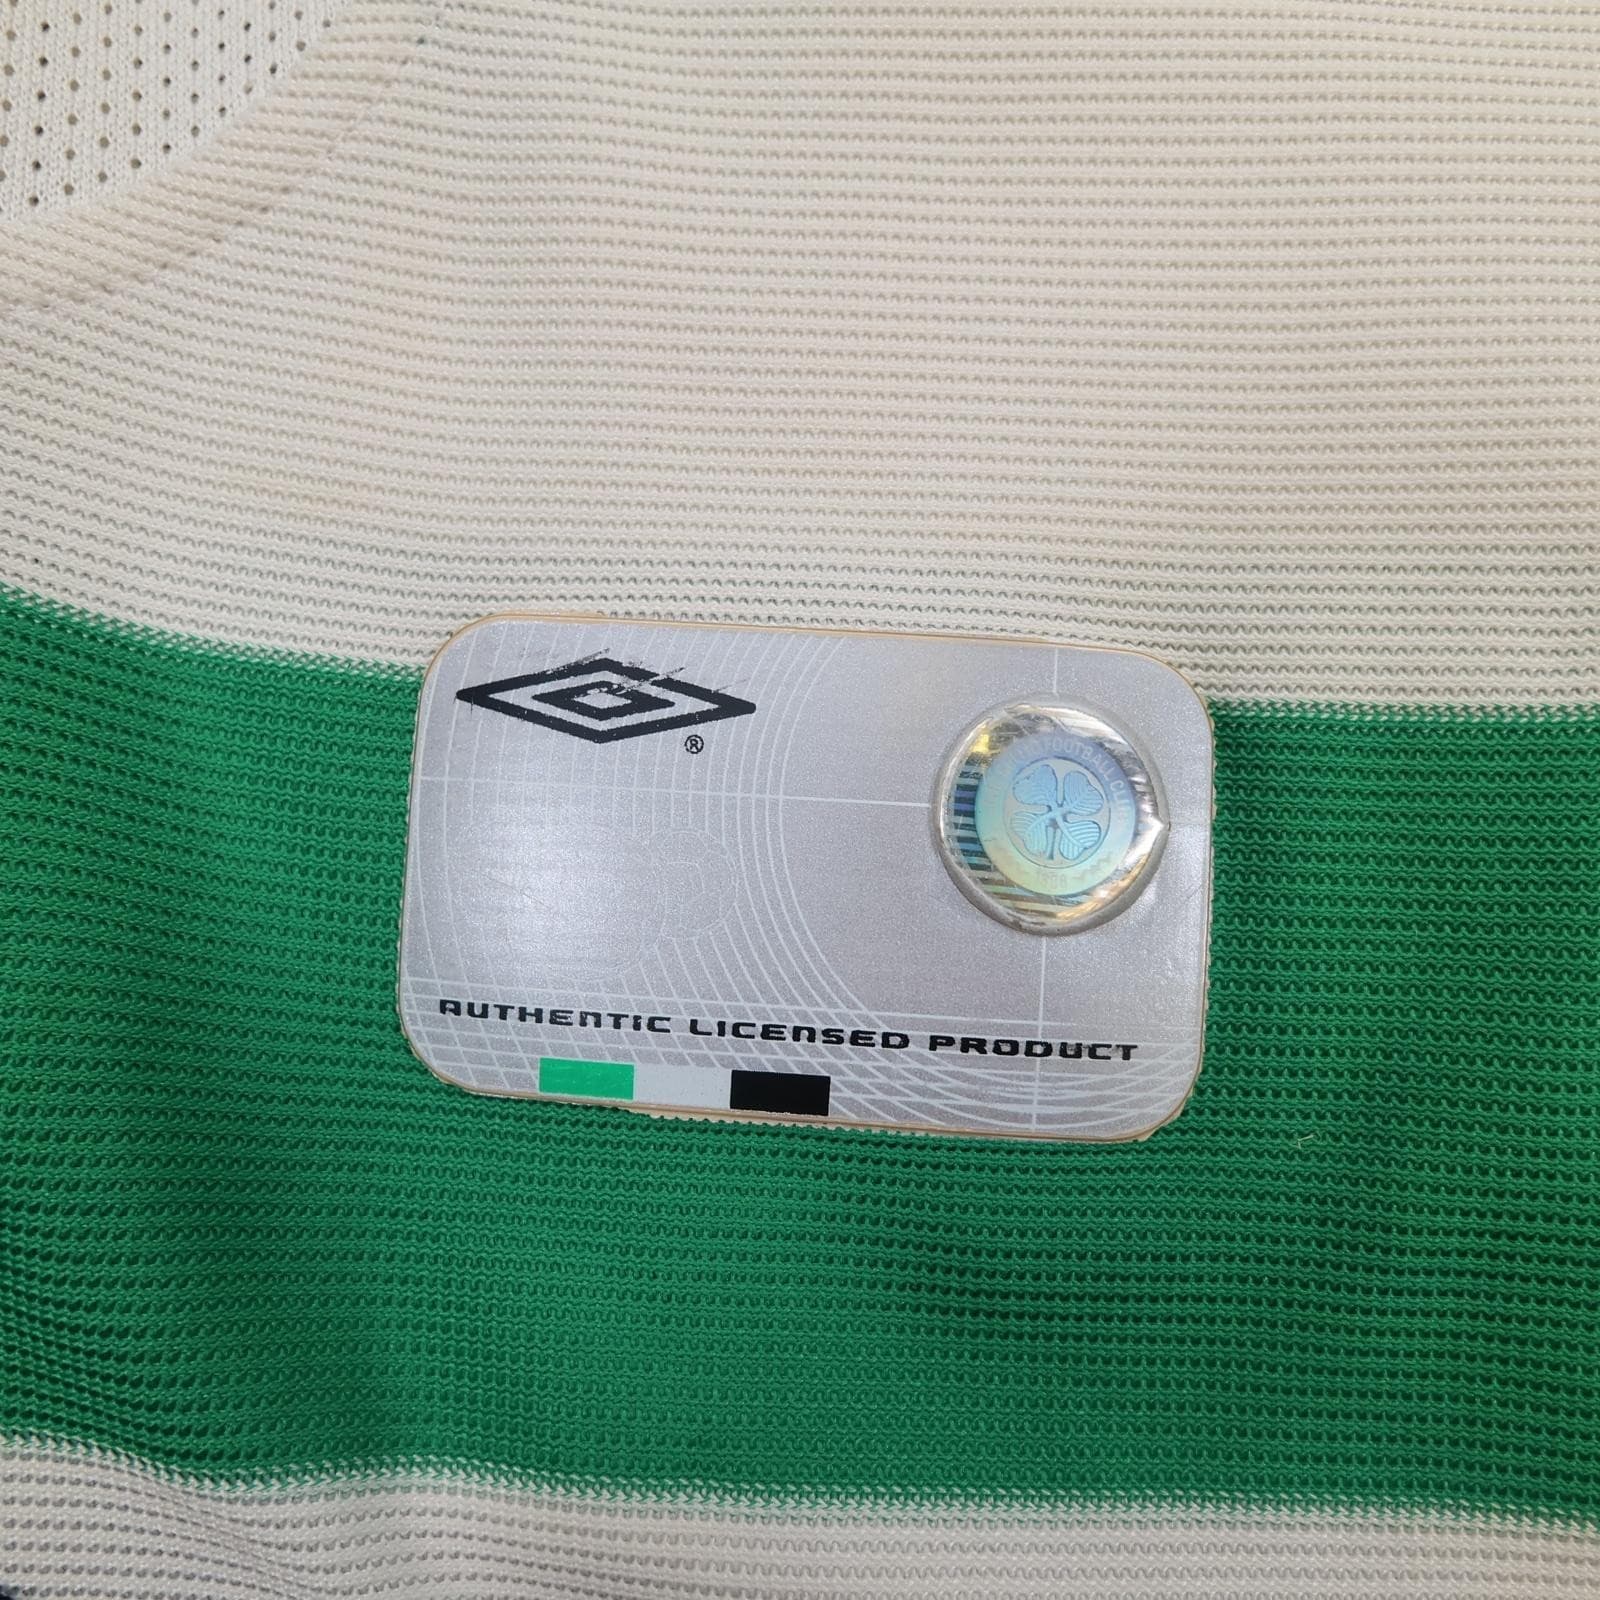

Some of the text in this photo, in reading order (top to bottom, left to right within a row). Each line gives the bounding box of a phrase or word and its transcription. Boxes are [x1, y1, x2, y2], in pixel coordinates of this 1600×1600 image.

[439, 999, 1139, 1061] AUTHENTIC LICENSED PRODUCT
